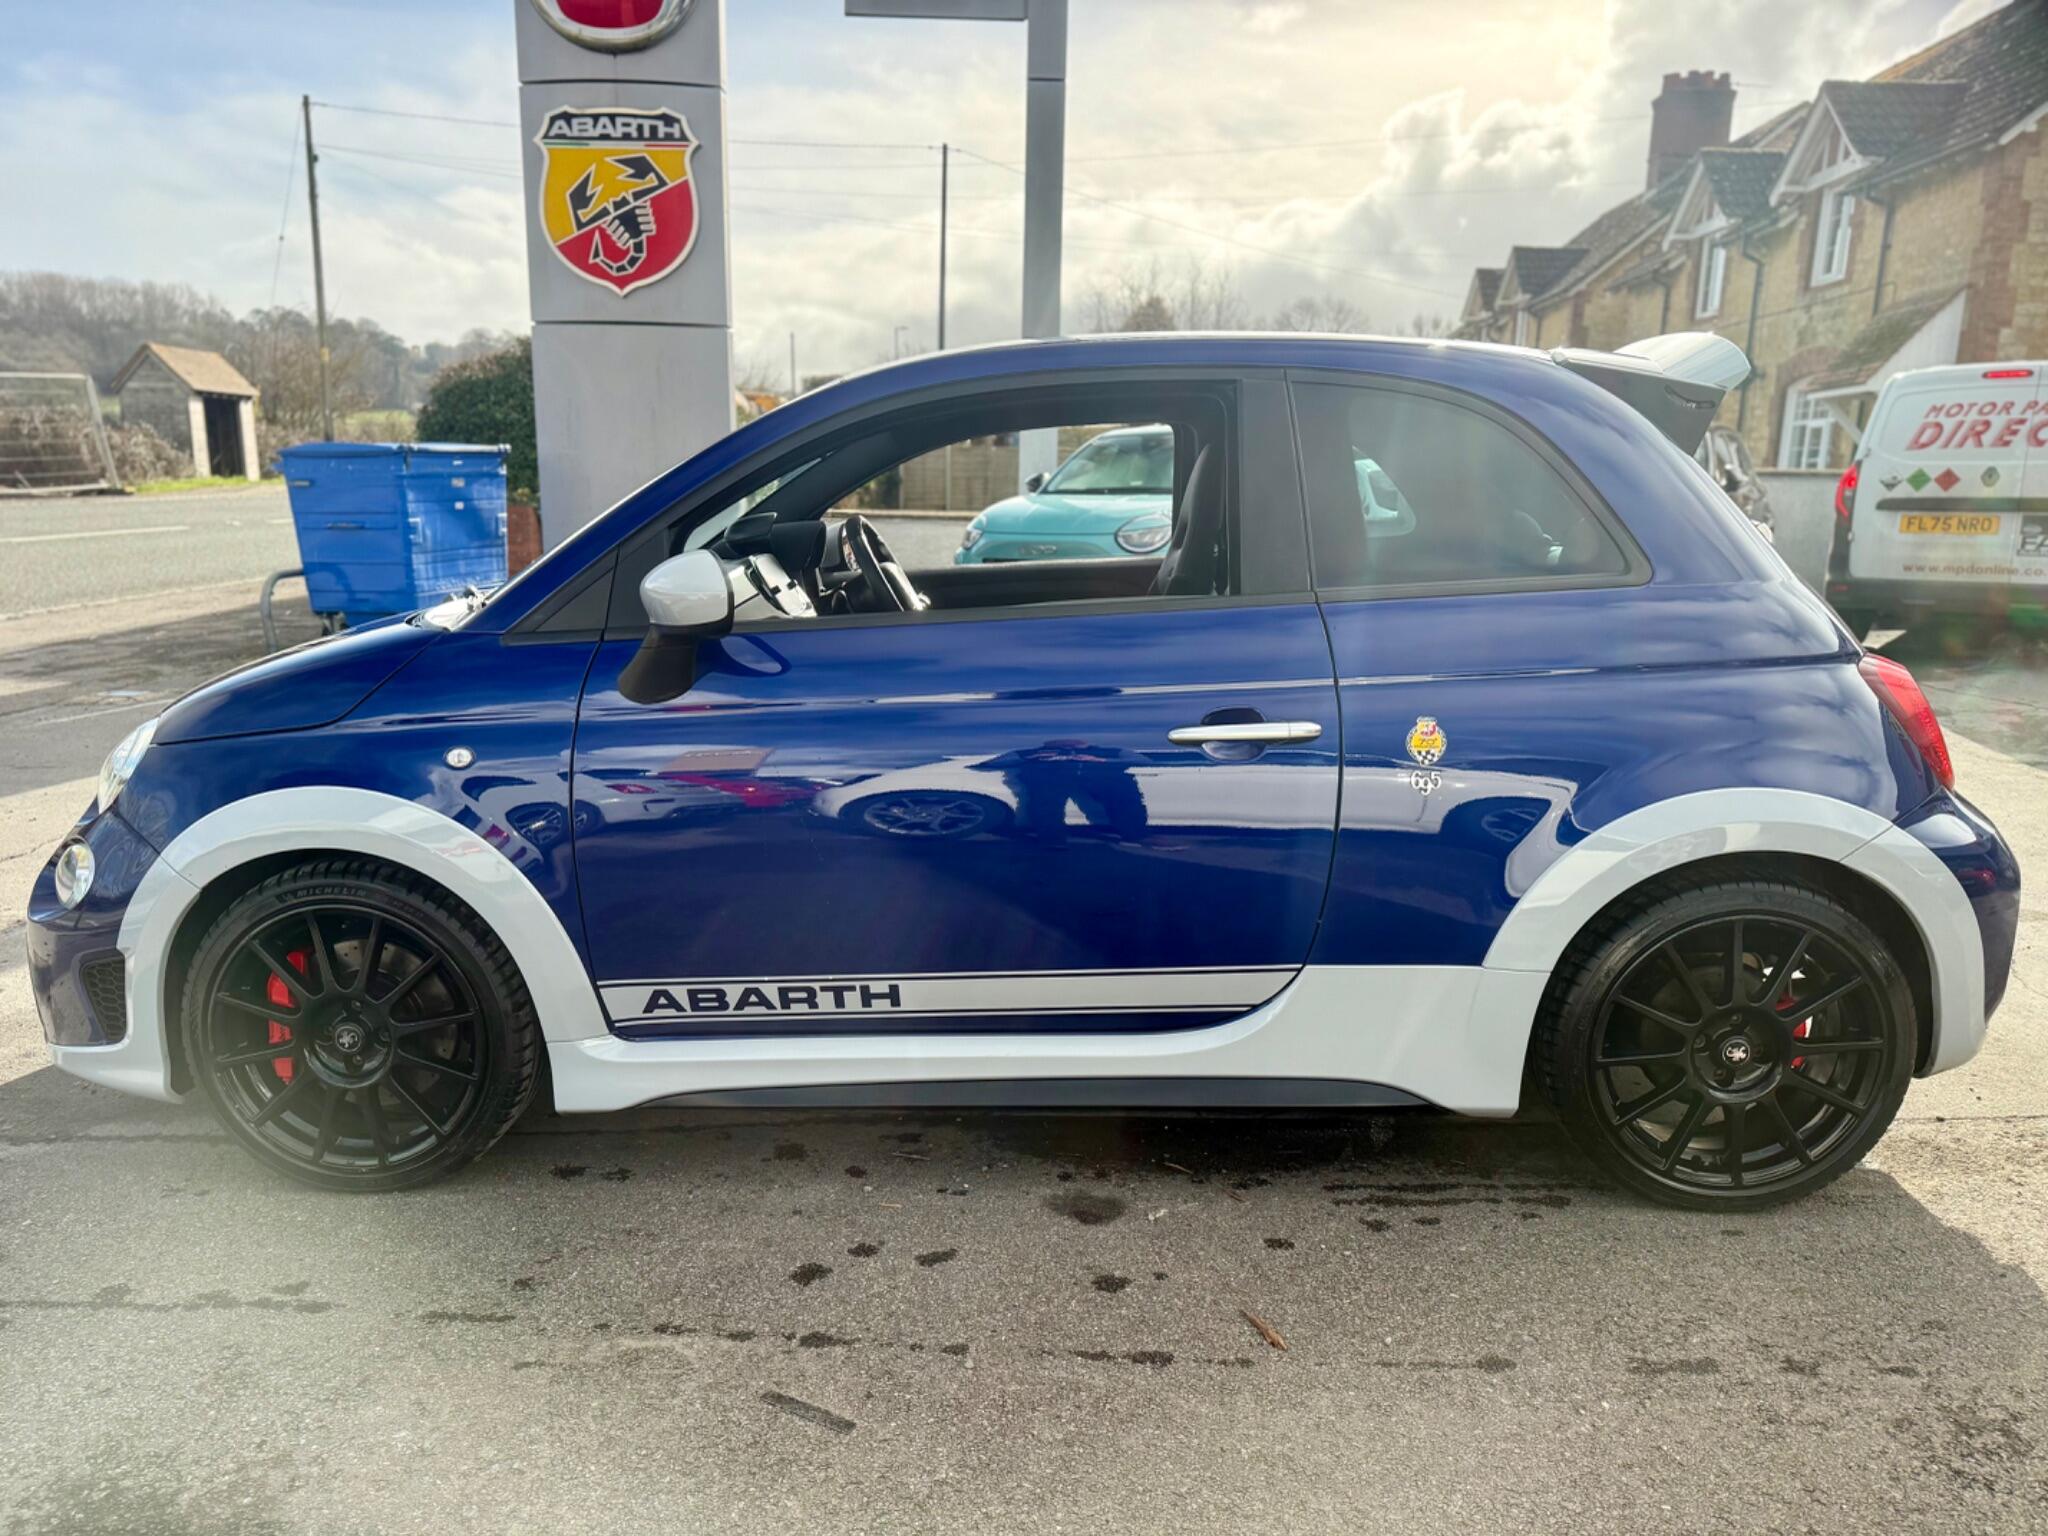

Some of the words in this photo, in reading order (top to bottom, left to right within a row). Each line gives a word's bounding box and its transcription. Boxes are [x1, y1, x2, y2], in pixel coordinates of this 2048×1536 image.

[549, 115, 681, 139] ABARTH
[1924, 401, 2015, 419] MOTOR
[1904, 418, 2048, 450] DIREC
[1905, 515, 1952, 532] FL75
[1410, 770, 1442, 796] 695
[296, 886, 367, 898] MICHELIN
[642, 984, 902, 1014] ABARTH
